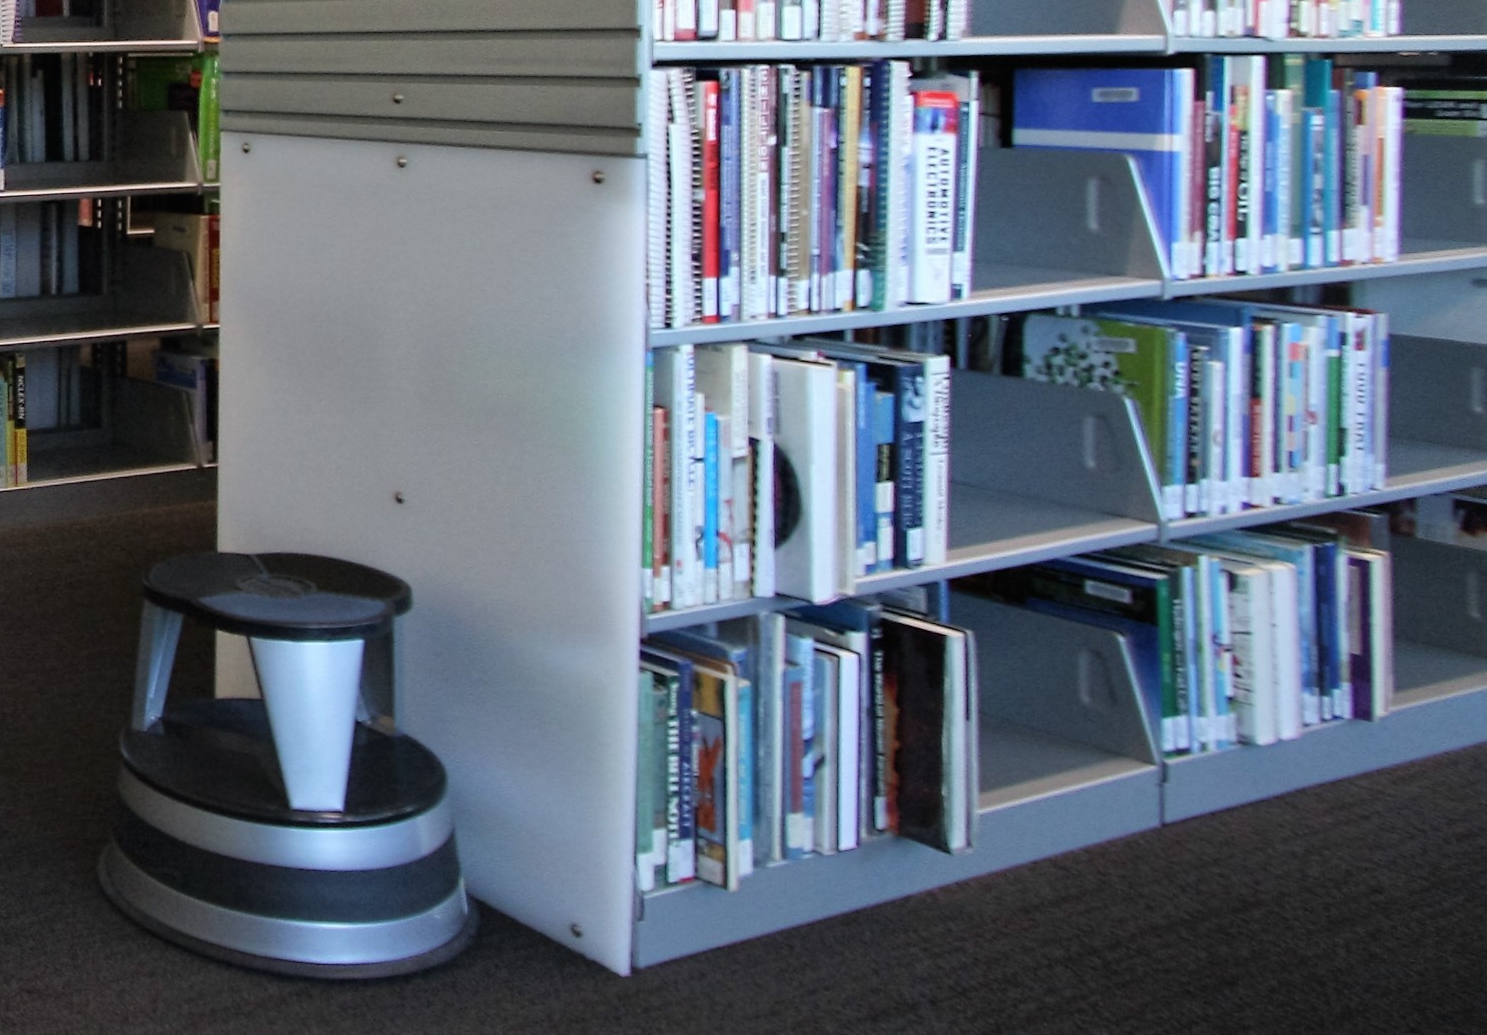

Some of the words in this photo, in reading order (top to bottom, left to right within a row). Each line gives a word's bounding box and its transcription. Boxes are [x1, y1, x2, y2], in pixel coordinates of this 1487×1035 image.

[926, 147, 937, 244] ELECTRONICS
[940, 149, 950, 242] AUTOMOTIVE
[1175, 362, 1188, 399] DNA
[681, 762, 691, 828] AIRCRAFT
